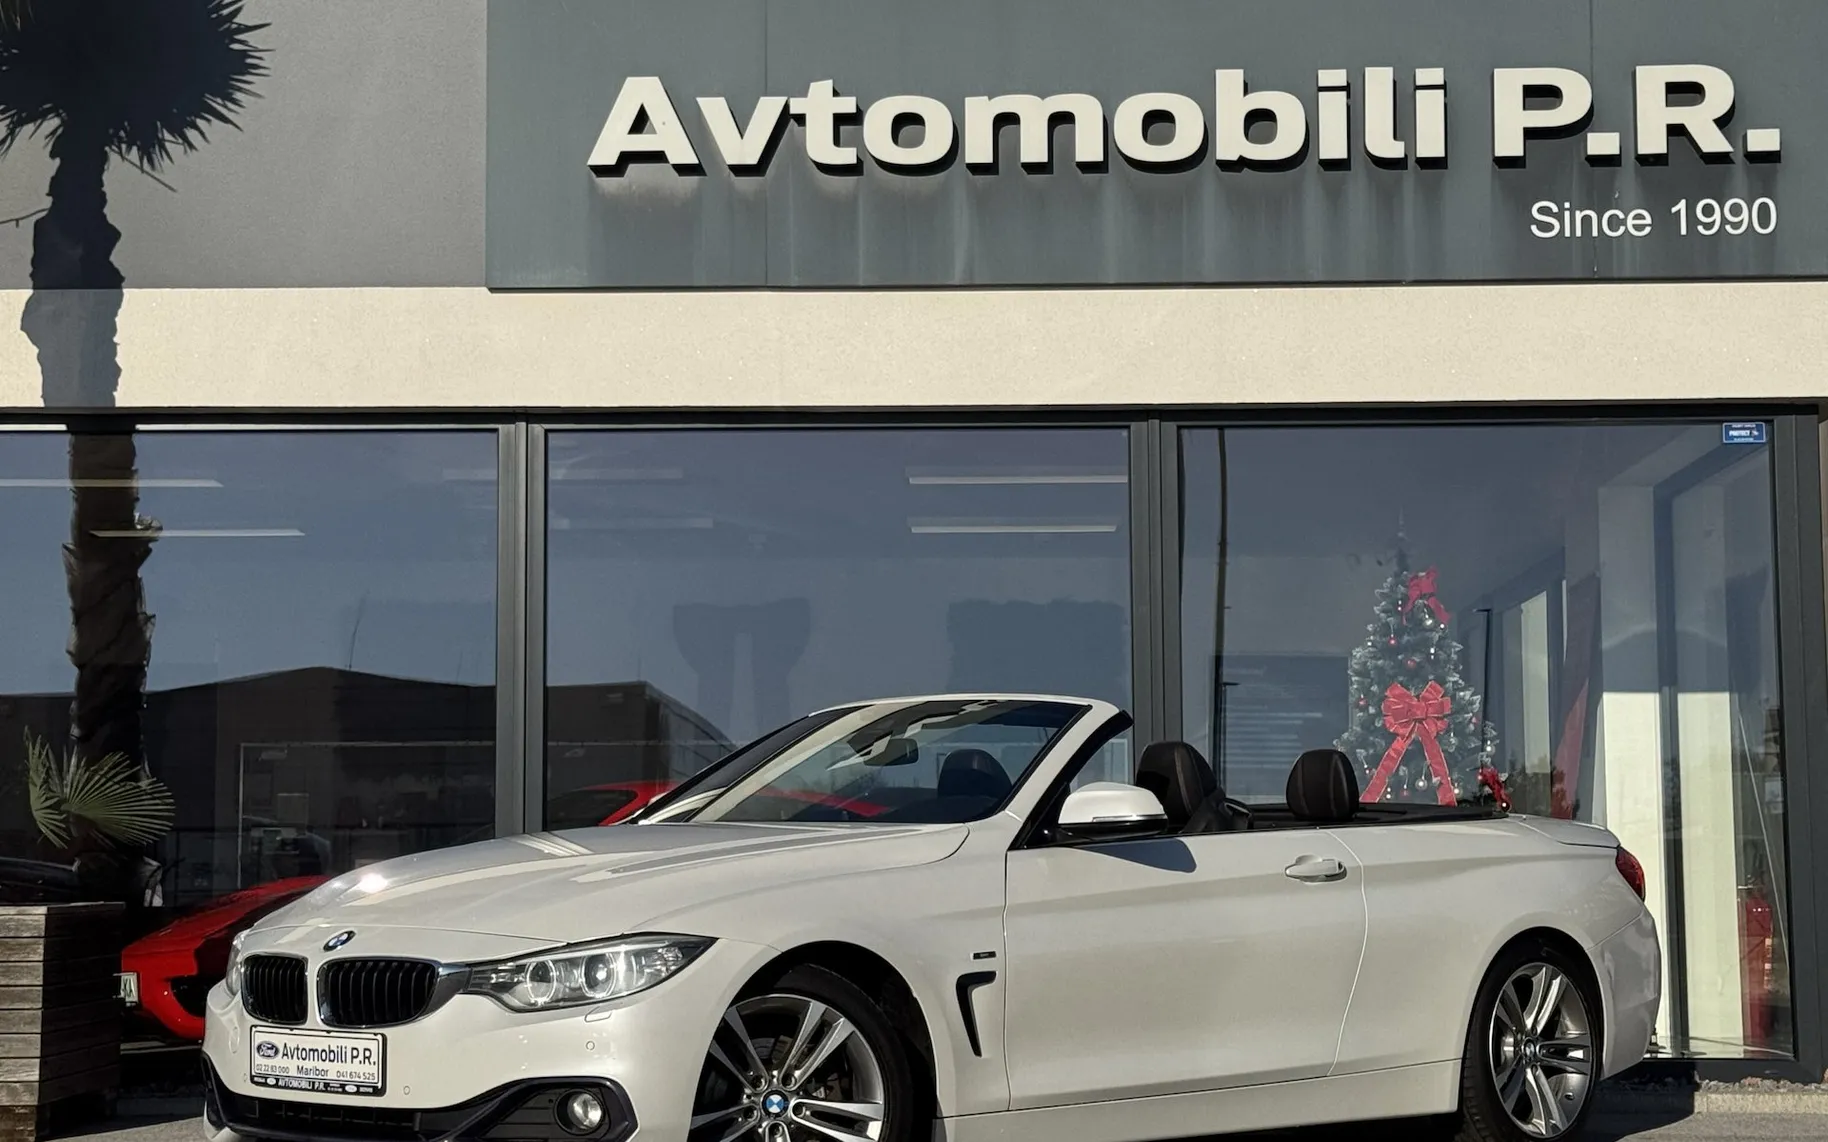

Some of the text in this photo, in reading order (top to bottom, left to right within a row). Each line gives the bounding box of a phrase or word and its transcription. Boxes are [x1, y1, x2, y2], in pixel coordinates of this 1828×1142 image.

[587, 64, 1781, 166] Avtomobili P.R.
[1530, 197, 1778, 238] Since 1990
[281, 1043, 348, 1064] Avtomobili
[350, 1047, 377, 1066] P.R.
[278, 1078, 313, 1090] AVTOMOBILI
[296, 1065, 329, 1077] Maribor
[336, 1070, 348, 1079] 041
[349, 1071, 361, 1080] 674
[363, 1072, 376, 1081] 525
